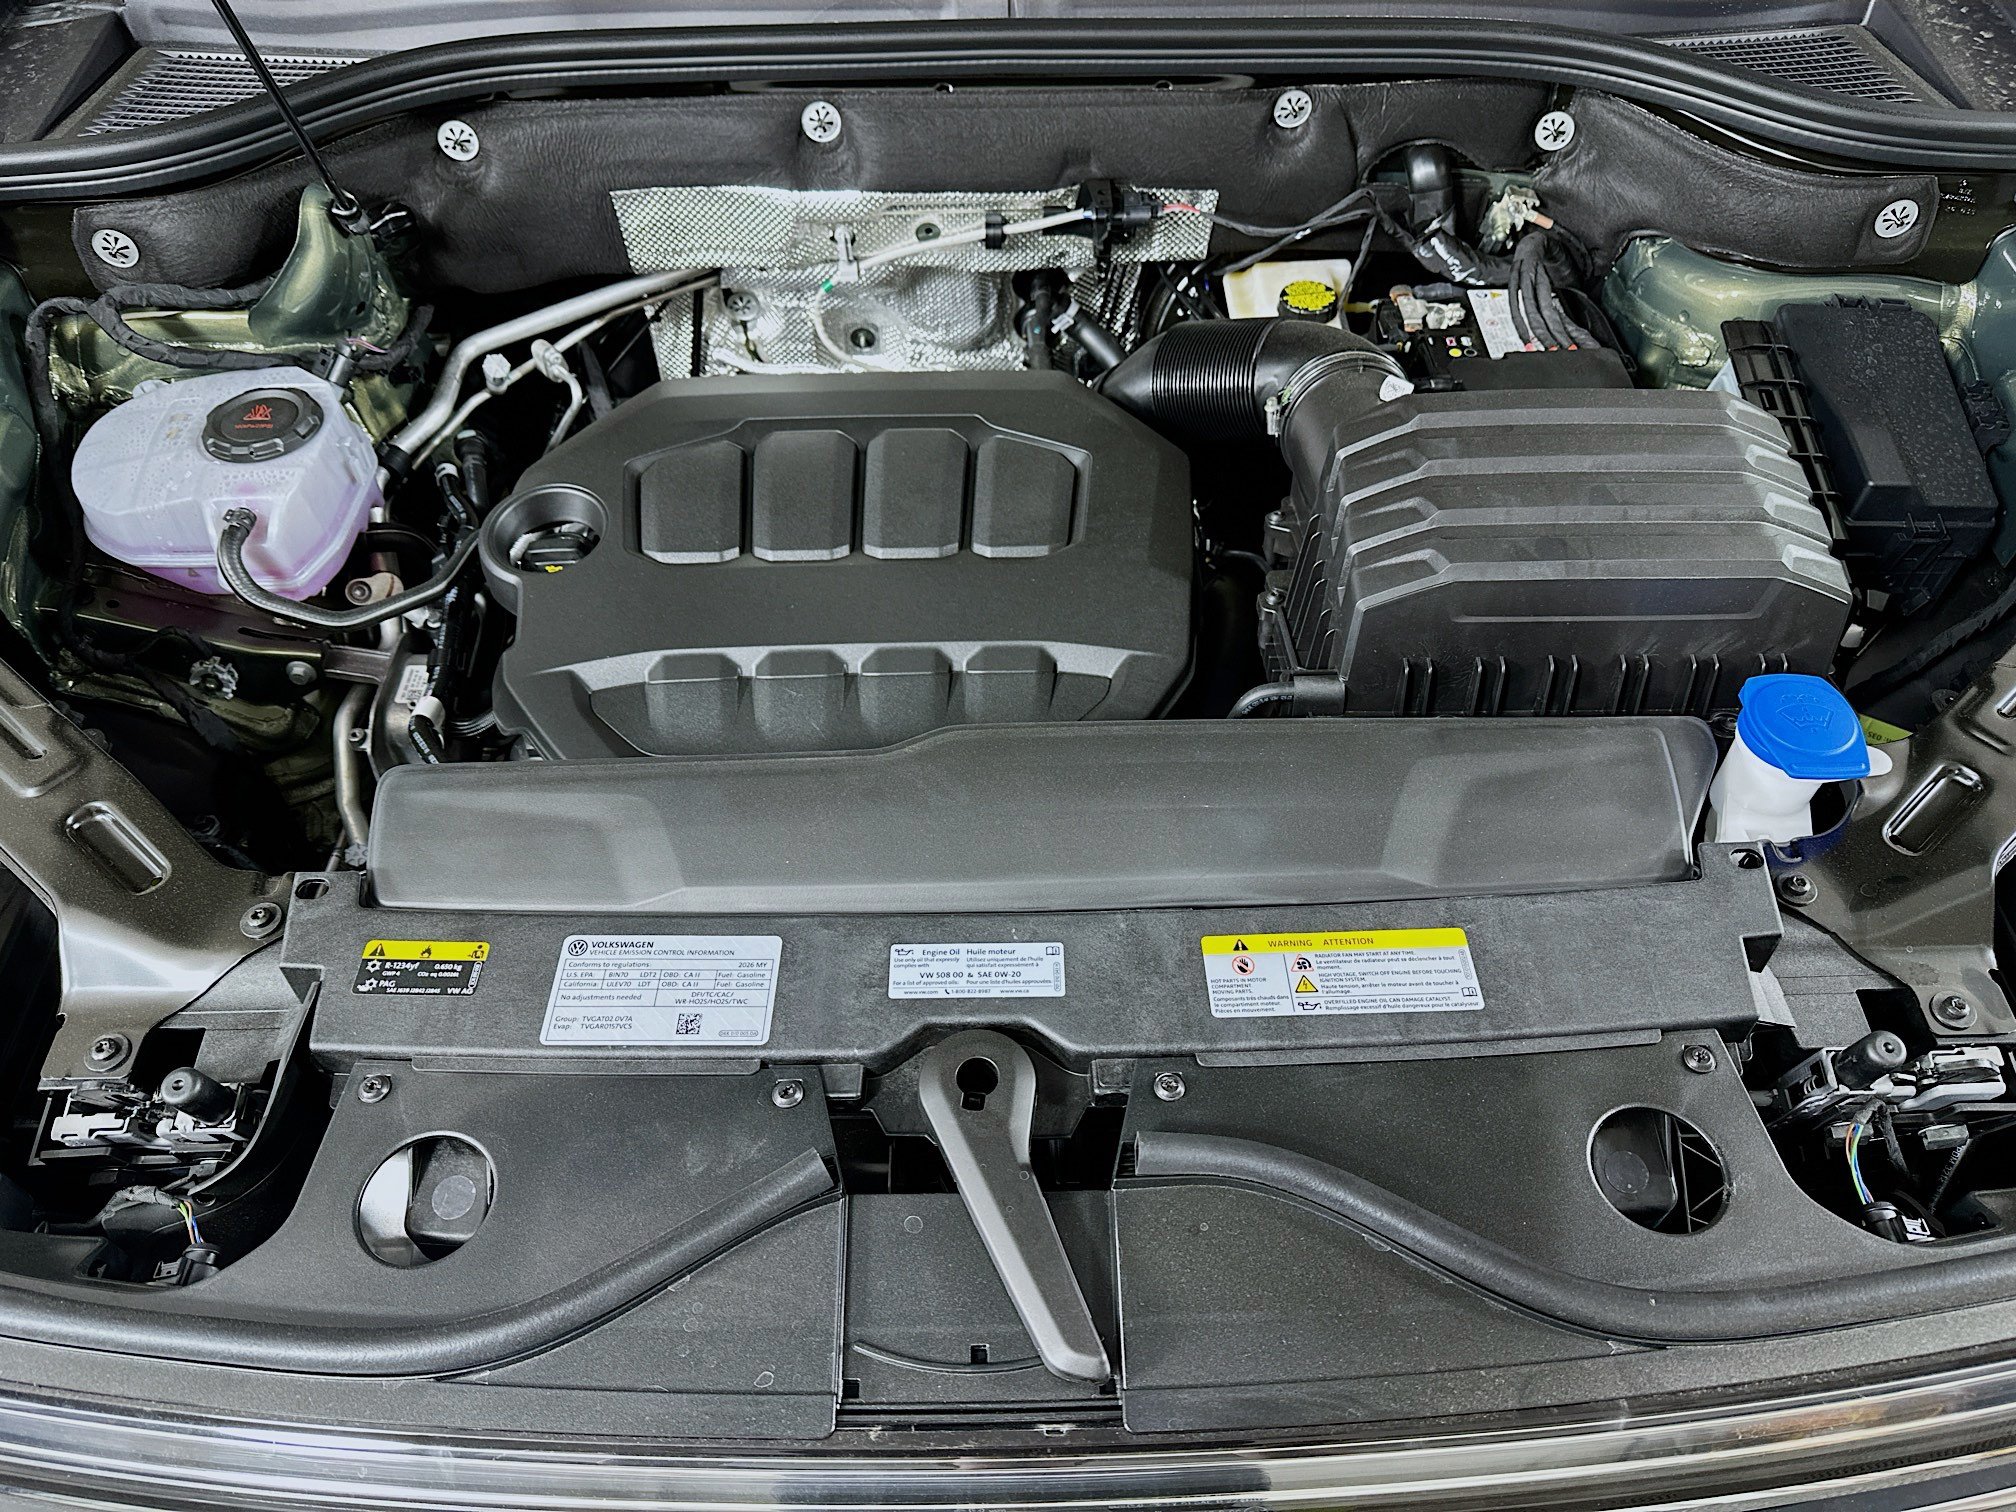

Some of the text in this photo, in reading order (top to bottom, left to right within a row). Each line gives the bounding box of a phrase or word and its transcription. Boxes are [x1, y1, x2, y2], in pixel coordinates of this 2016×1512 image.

[591, 941, 654, 949] VOLKSWAGEN
[1267, 937, 1374, 948] WARNING ATTENTION
[922, 949, 948, 957] Engine
[384, 961, 420, 971] R-1234yf
[453, 963, 463, 972] kg
[378, 980, 396, 988] PAG
[461, 987, 475, 995] AG
[572, 994, 615, 1002] adjustments
